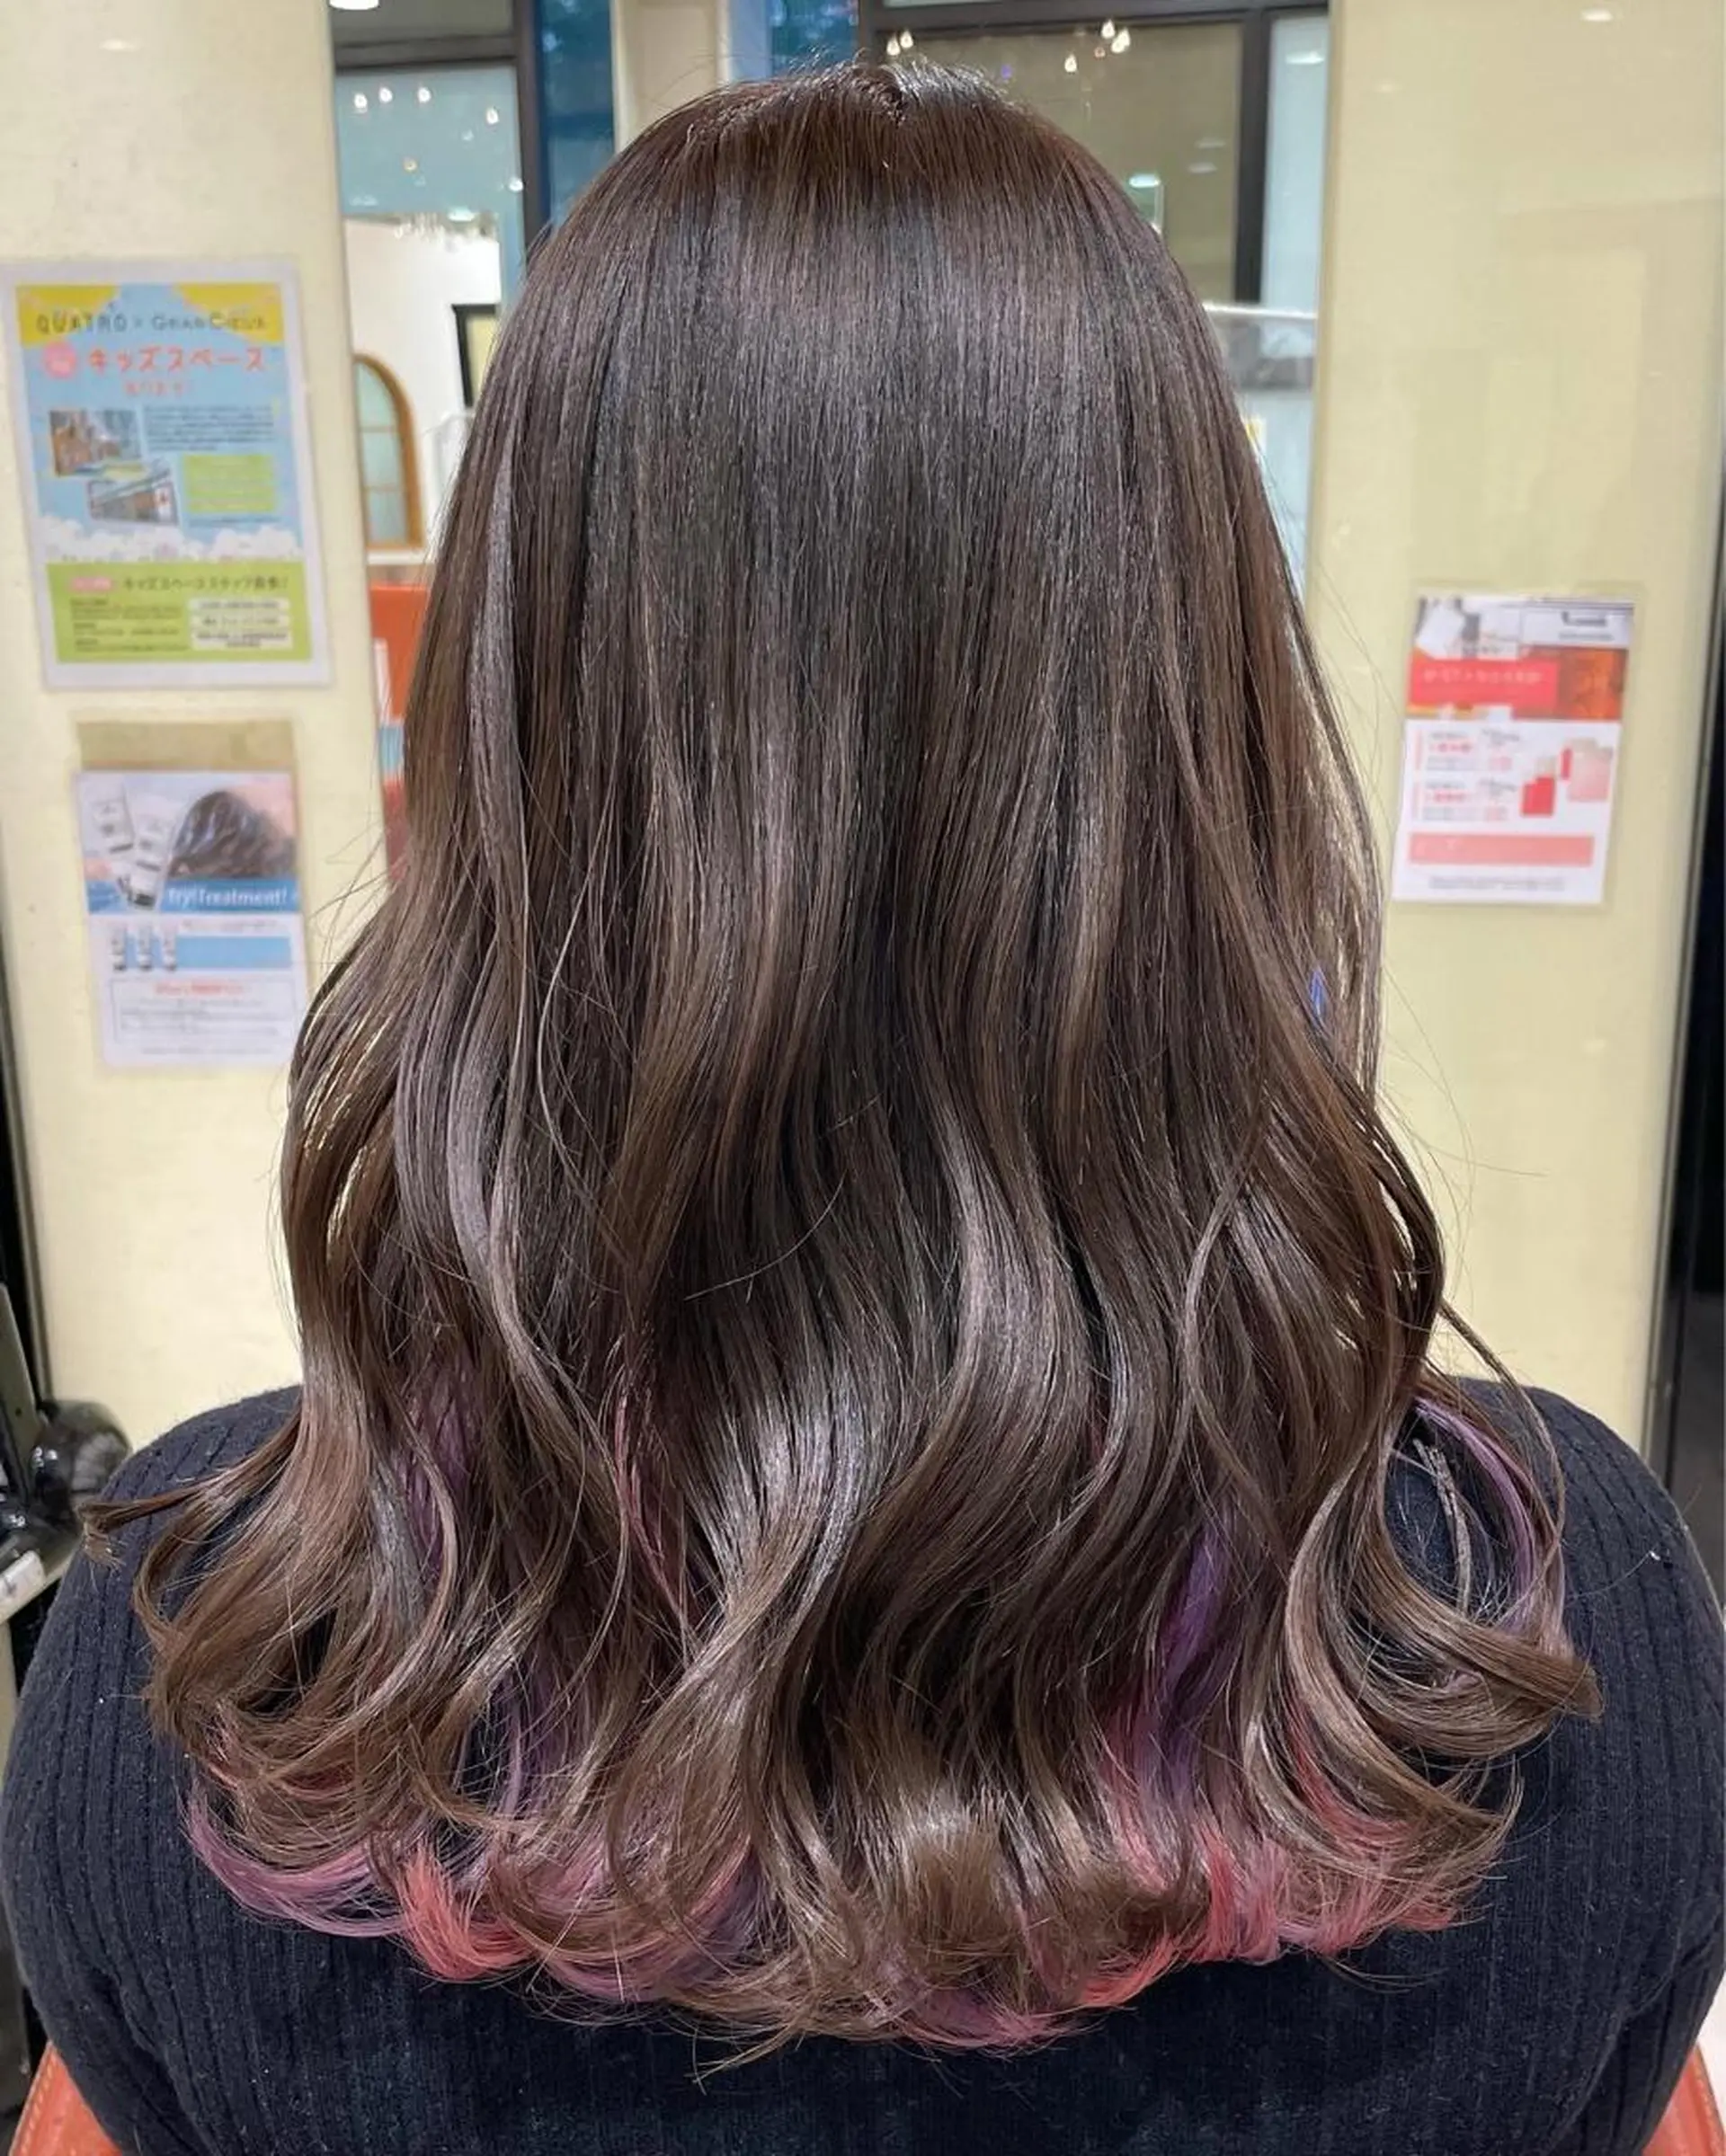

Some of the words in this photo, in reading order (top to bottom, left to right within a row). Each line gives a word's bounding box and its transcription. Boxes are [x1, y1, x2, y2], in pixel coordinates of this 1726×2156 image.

[88, 345, 264, 374] キッズスペース
